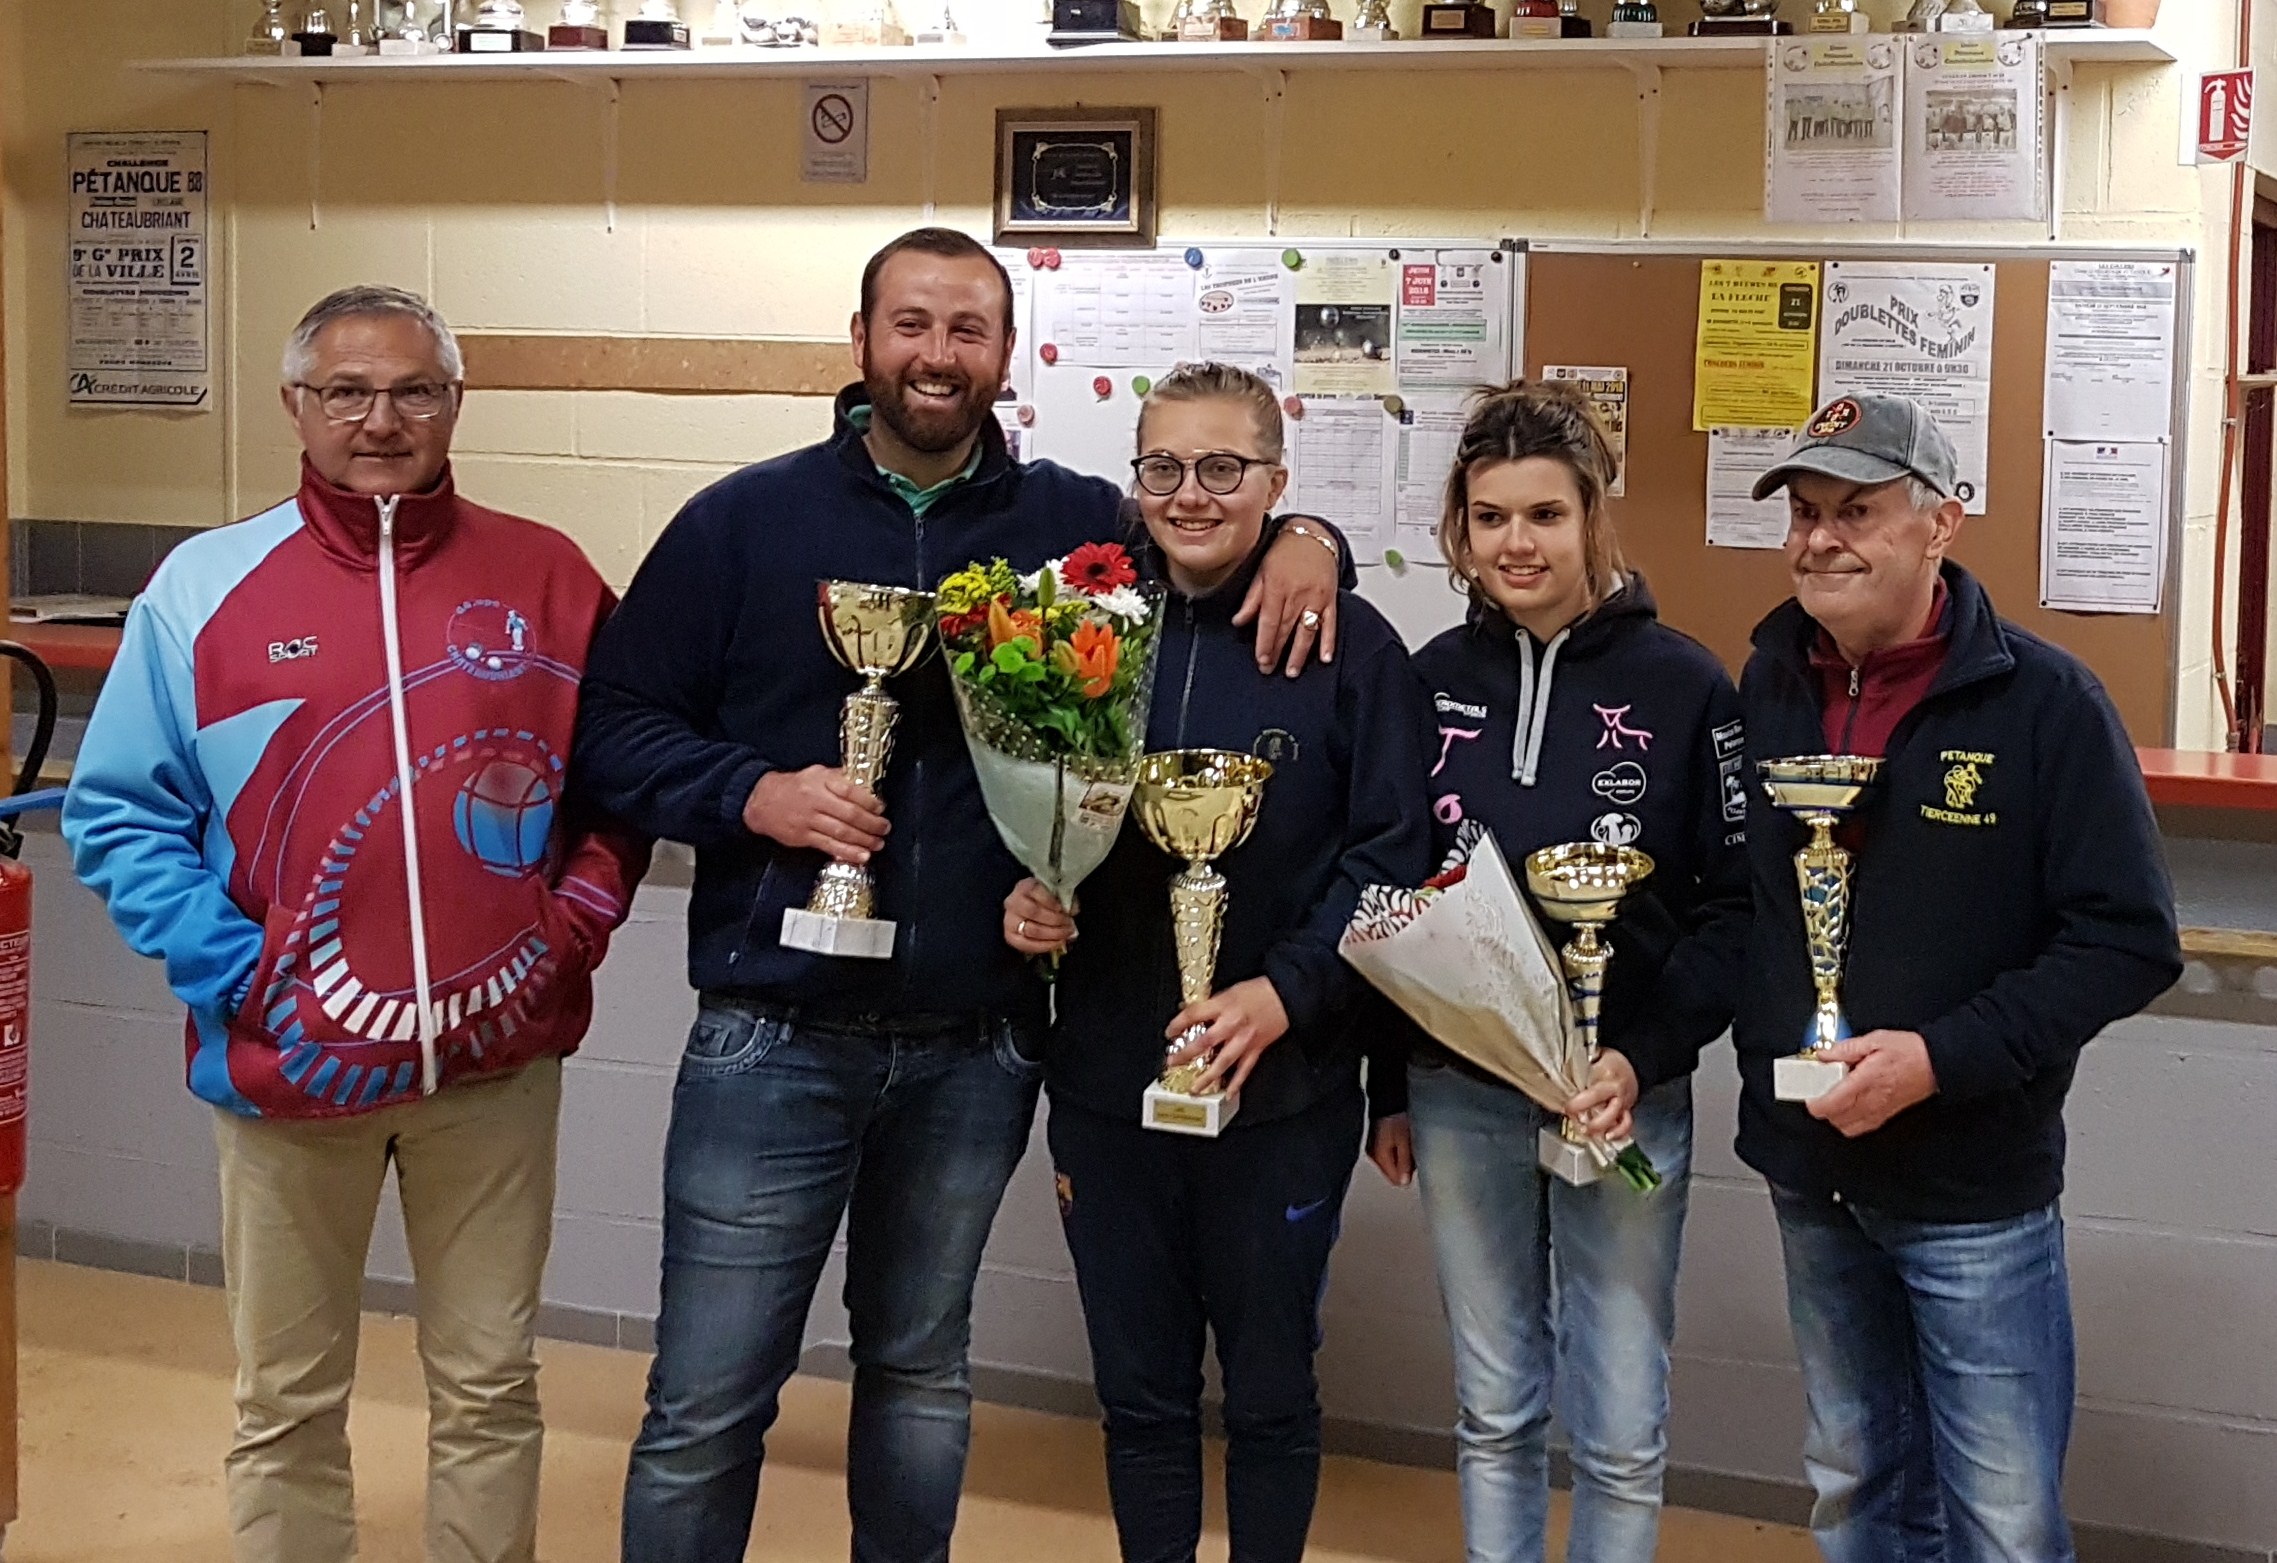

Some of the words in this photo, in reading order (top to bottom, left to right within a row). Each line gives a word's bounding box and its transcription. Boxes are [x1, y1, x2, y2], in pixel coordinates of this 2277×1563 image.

[73, 168, 182, 193] PÉTANQUE
[82, 211, 191, 228] CHATEAUBRIANT
[118, 248, 164, 262] PRIX
[180, 246, 195, 268] 2
[106, 264, 164, 278] VILLE
[1889, 294, 1919, 328] PRIX
[1834, 303, 1918, 346] DOUBLETTES
[1919, 325, 1976, 359] FEMININ
[1835, 360, 1881, 372] DIMANCHE
[1883, 361, 1893, 372] 21
[1895, 361, 1935, 373] OCTOBRE
[141, 384, 200, 396] AGRICOLE
[1940, 750, 1995, 764] PETANQUE
